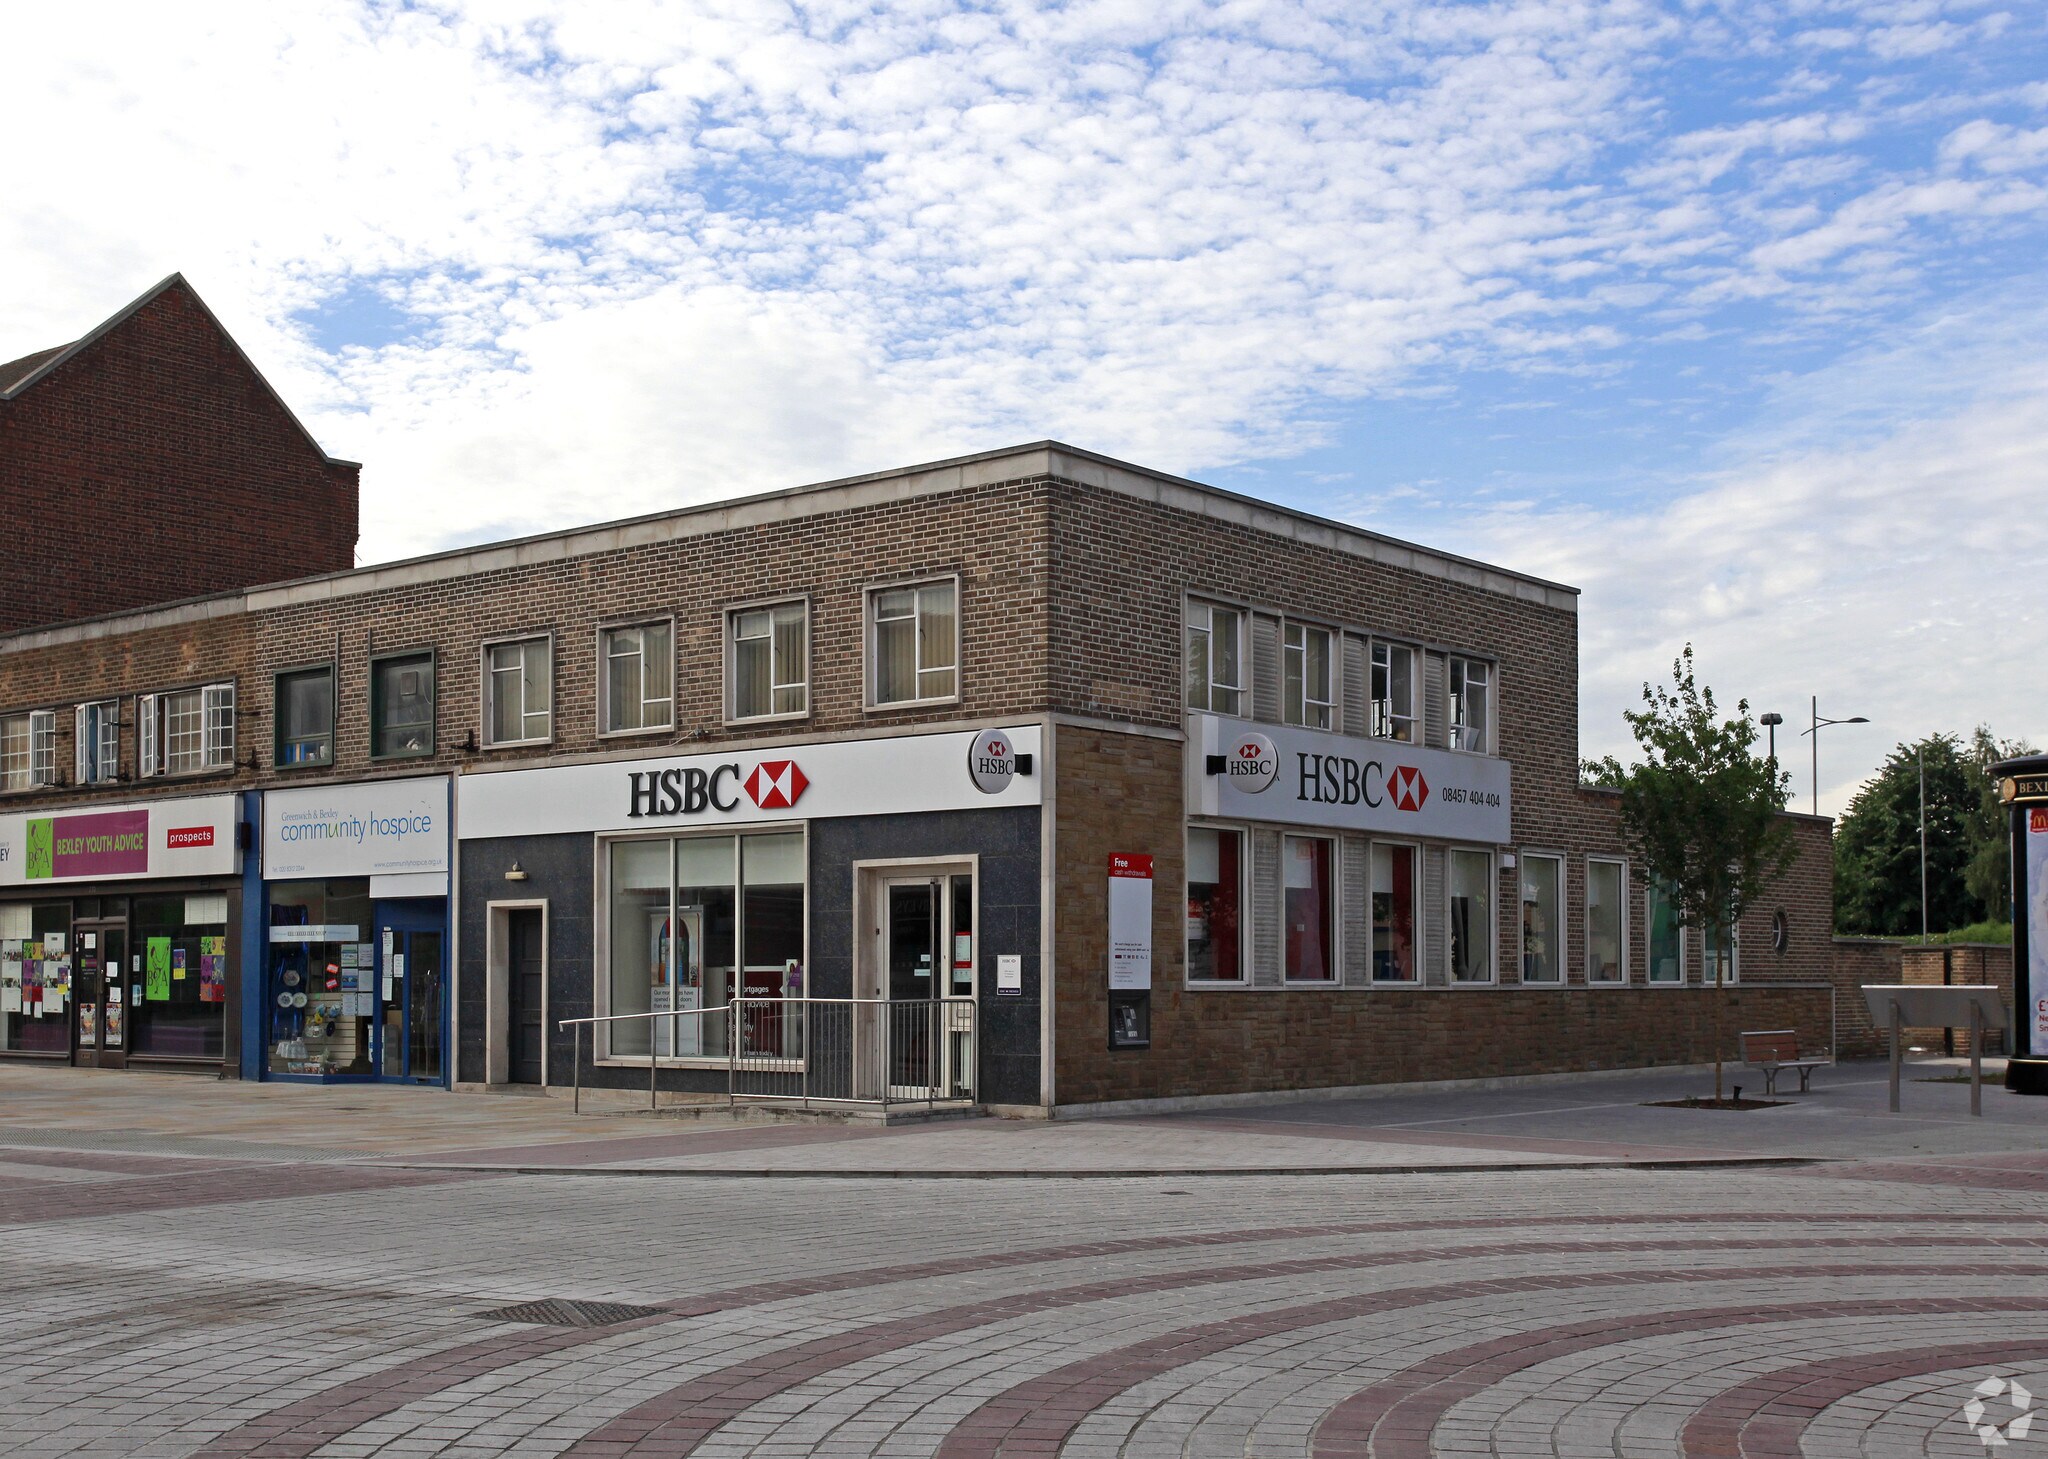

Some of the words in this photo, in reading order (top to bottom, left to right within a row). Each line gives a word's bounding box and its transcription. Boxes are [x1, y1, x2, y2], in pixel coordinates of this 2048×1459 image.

[978, 757, 1014, 776] HSBC
[1230, 760, 1271, 776] HSBC
[1296, 752, 1383, 809] HSBC
[627, 763, 740, 818] HSBC
[1442, 786, 1467, 804] 08457
[1469, 789, 1484, 806] 404
[1486, 791, 1500, 808] 404
[282, 810, 312, 822] Greenwich
[313, 810, 318, 818] &
[320, 808, 338, 820] Bexley
[281, 814, 366, 844] community
[370, 810, 432, 841] hospice
[57, 838, 85, 855] BEXLEY
[86, 836, 112, 853] YOUTH
[114, 833, 144, 852] ADVICE
[170, 830, 211, 844] prospects
[1114, 858, 1128, 868] Free
[744, 986, 769, 995] ortgages
